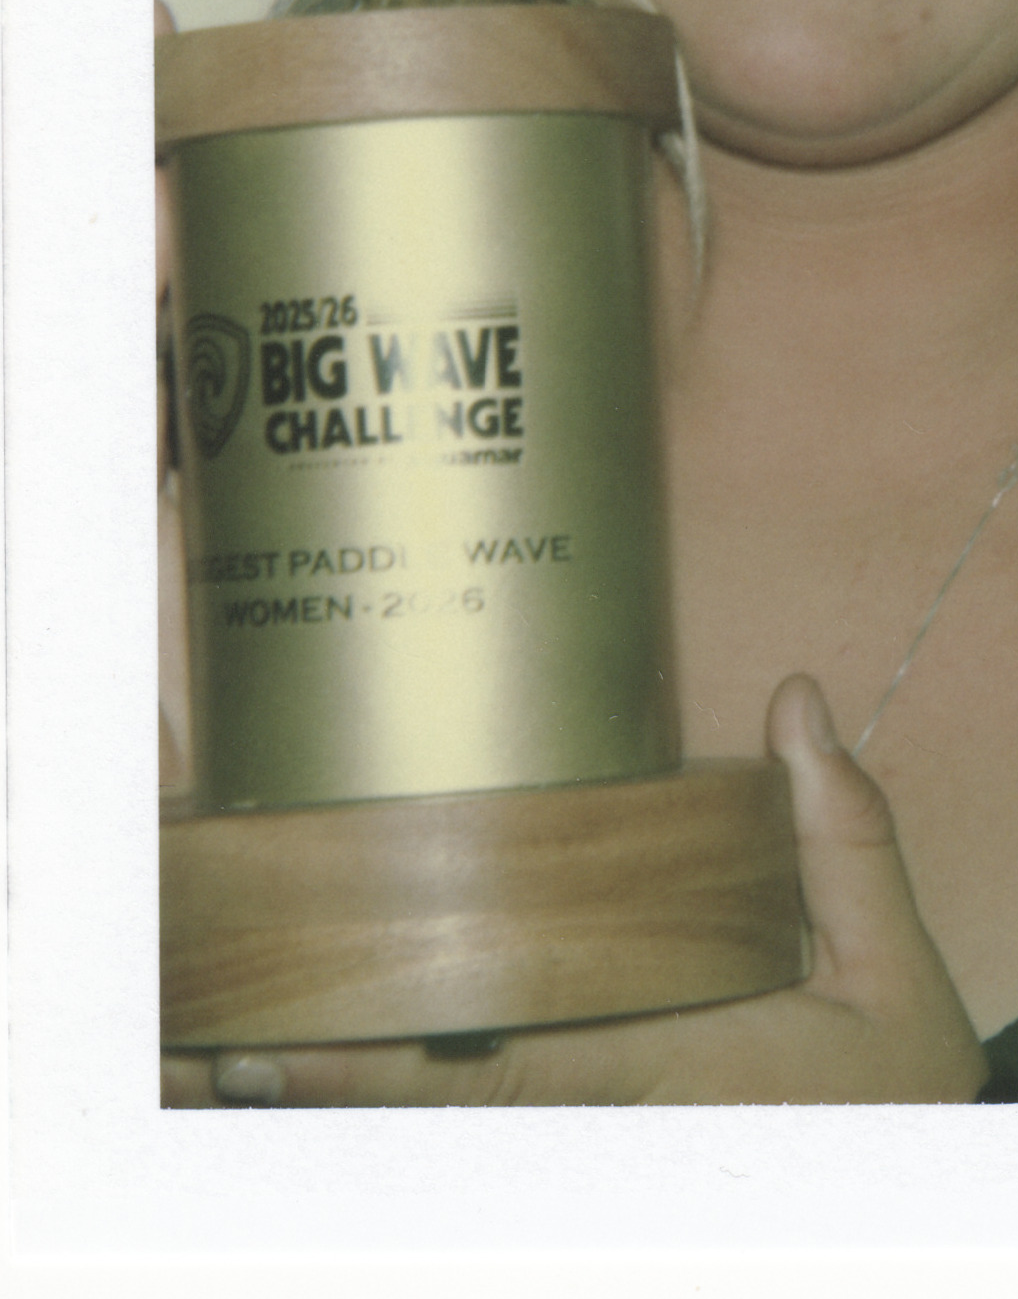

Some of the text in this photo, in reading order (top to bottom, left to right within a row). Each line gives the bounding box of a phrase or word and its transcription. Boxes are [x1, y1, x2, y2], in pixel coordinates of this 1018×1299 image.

[260, 294, 359, 335] 2025/26
[260, 325, 523, 406] BIG WAVE
[265, 396, 525, 455] CHALLNGE
[288, 544, 412, 579] PADD
[463, 534, 573, 566] WAVE
[225, 593, 354, 628] WOMEN
